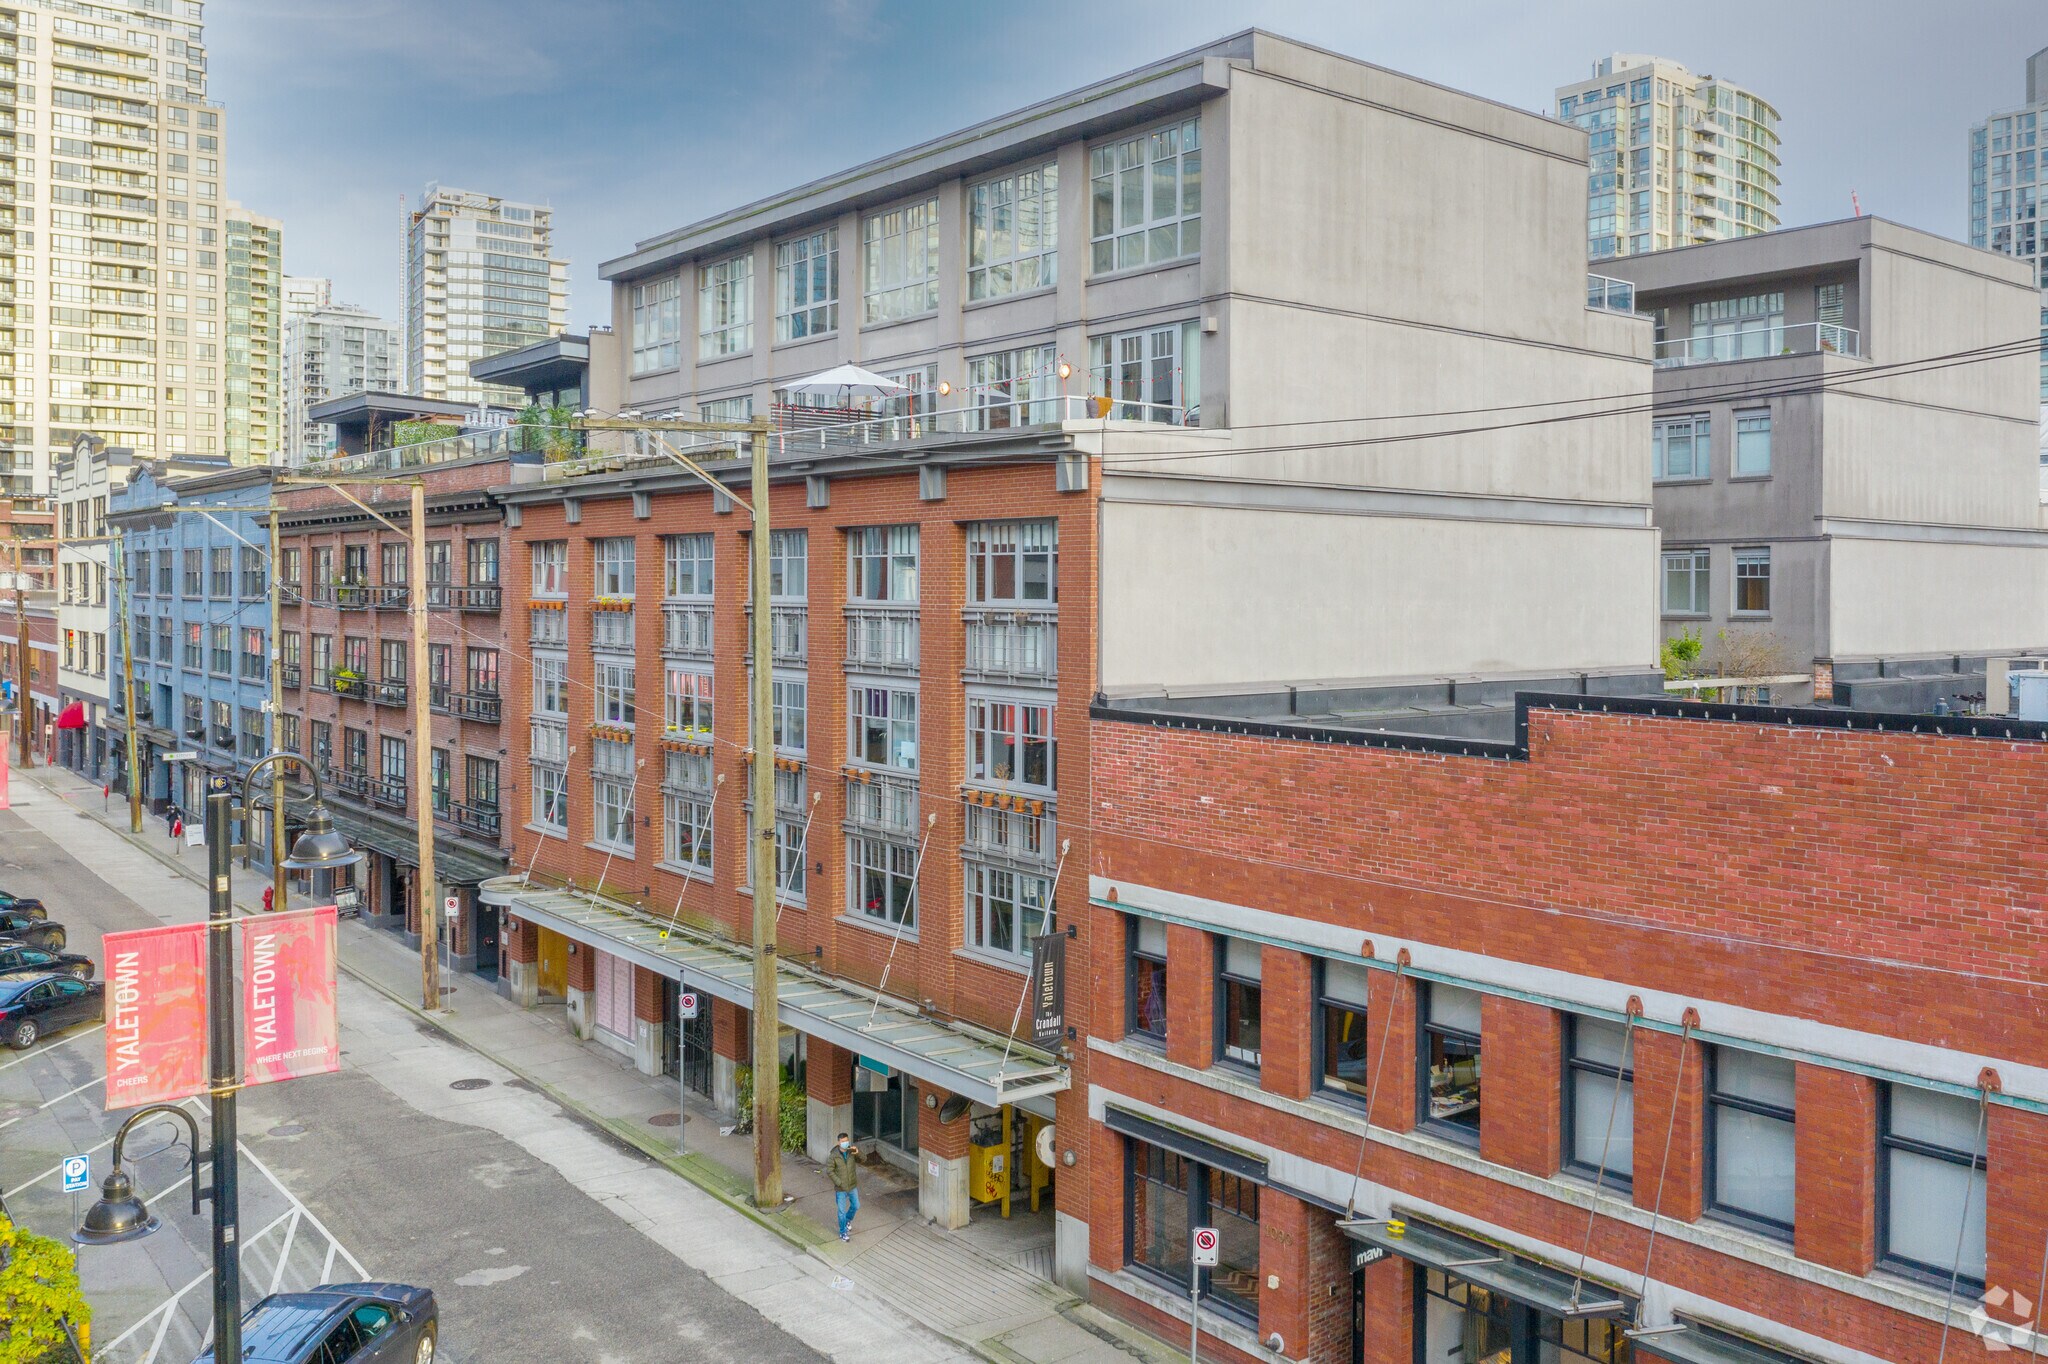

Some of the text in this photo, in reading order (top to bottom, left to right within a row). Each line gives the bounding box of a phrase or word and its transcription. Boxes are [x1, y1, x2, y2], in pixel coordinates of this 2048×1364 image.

[253, 934, 277, 1050] YALETOWN
[1042, 961, 1054, 1008] Yaletown
[114, 952, 139, 1072] YALETOWN
[1035, 1015, 1061, 1030] Crandall
[256, 1045, 329, 1065] WHERE NEXT BEGINS
[116, 1075, 149, 1088] CHEERS
[73, 1162, 81, 1174] P
[1356, 1247, 1383, 1267] mavi
